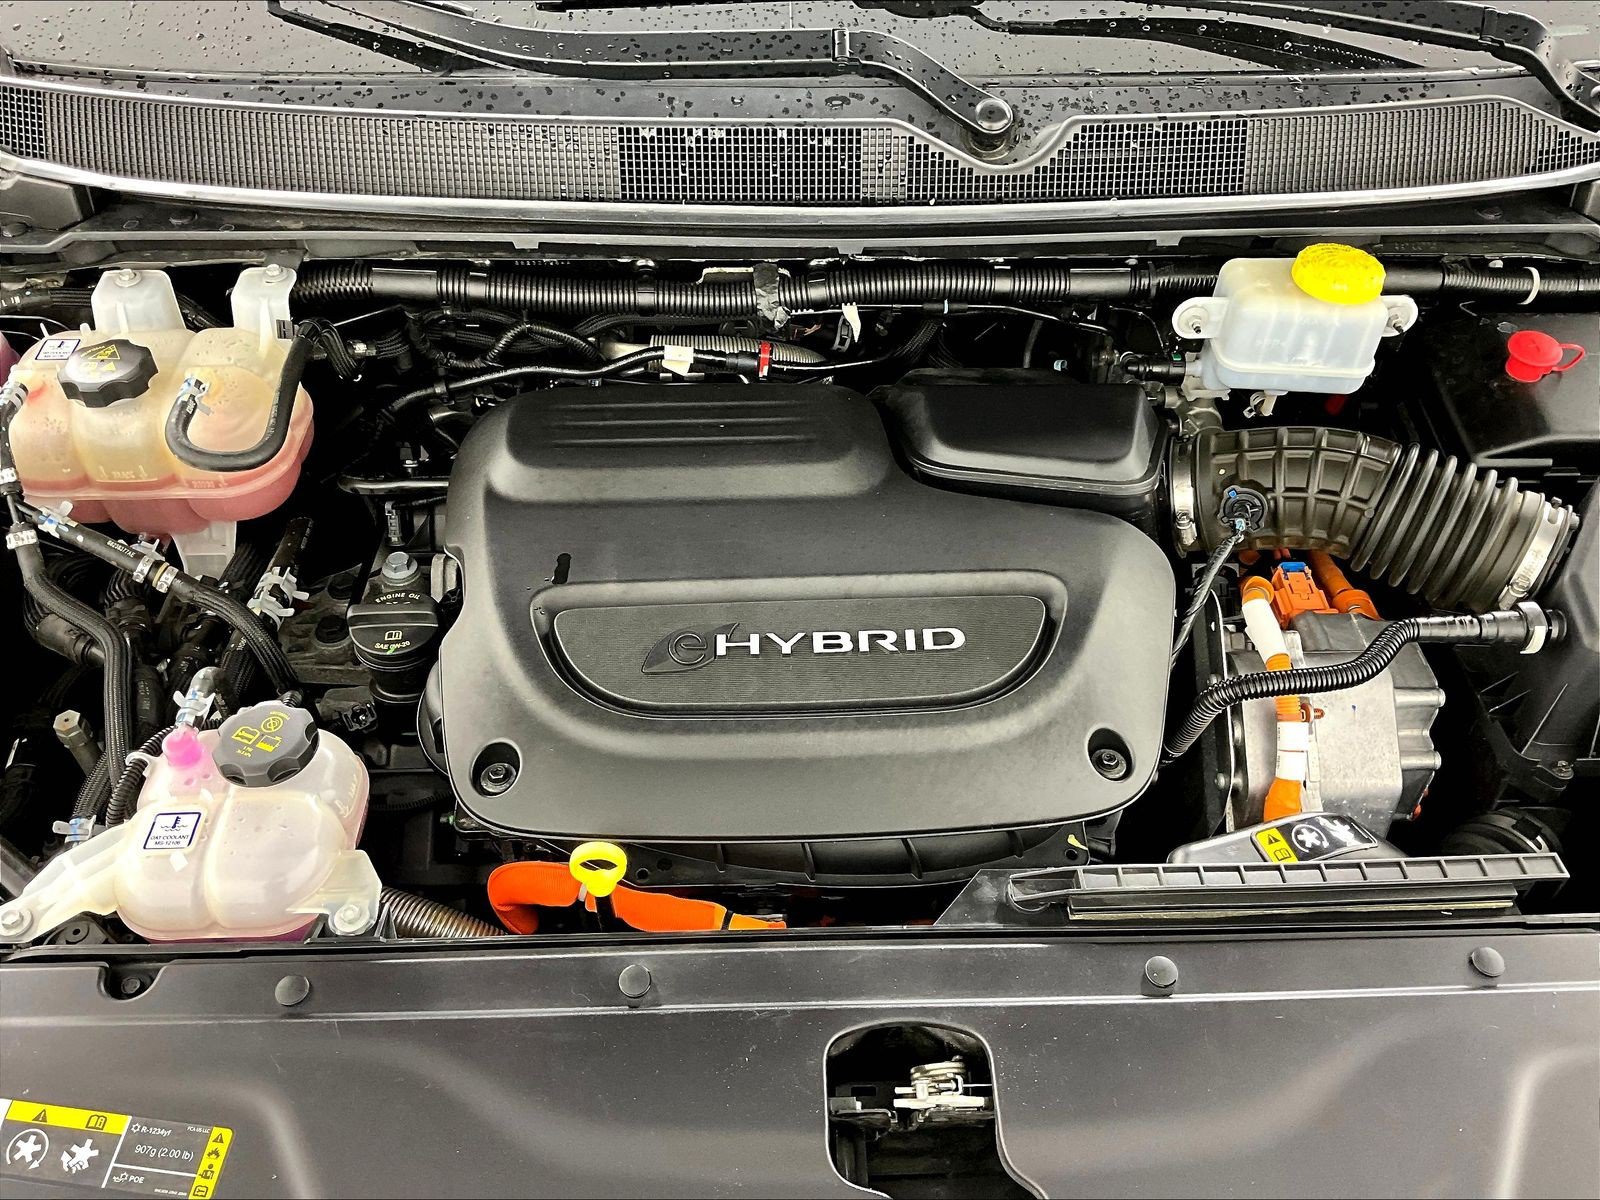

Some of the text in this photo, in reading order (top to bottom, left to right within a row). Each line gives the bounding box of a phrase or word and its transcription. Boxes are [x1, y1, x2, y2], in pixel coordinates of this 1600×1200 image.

[375, 592, 406, 603] ENGINE
[374, 642, 389, 650] SAE
[141, 1126, 172, 1137] R-1234yf
[135, 1144, 194, 1162] 907g (2.00 lb)
[129, 1175, 145, 1184] POE
